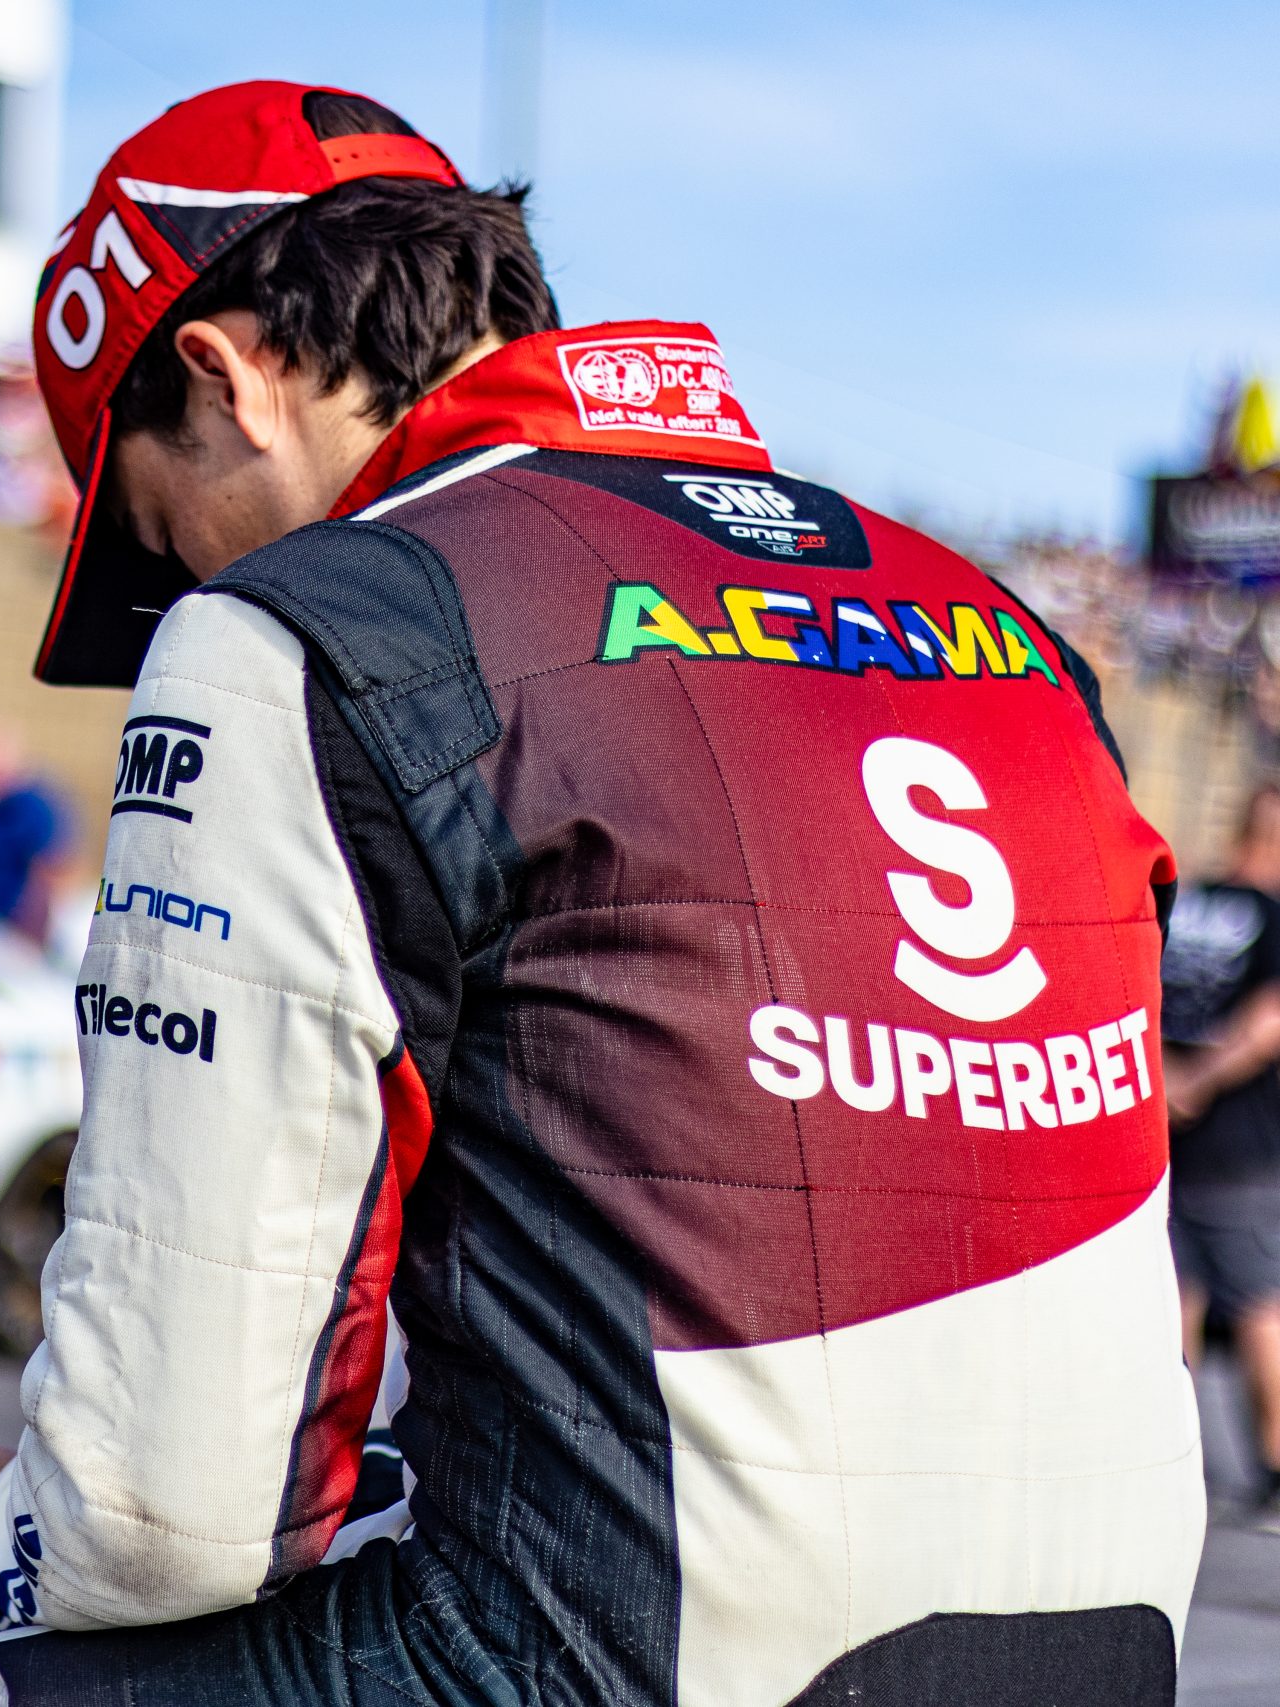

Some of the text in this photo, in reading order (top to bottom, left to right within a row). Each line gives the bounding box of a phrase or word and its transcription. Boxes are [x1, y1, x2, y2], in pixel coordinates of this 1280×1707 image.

[589, 408, 625, 424] Not
[627, 410, 664, 427] valid
[682, 483, 796, 520] OMP
[598, 580, 1062, 688] A.GAMA
[748, 1005, 1153, 1132] SUPERBET
